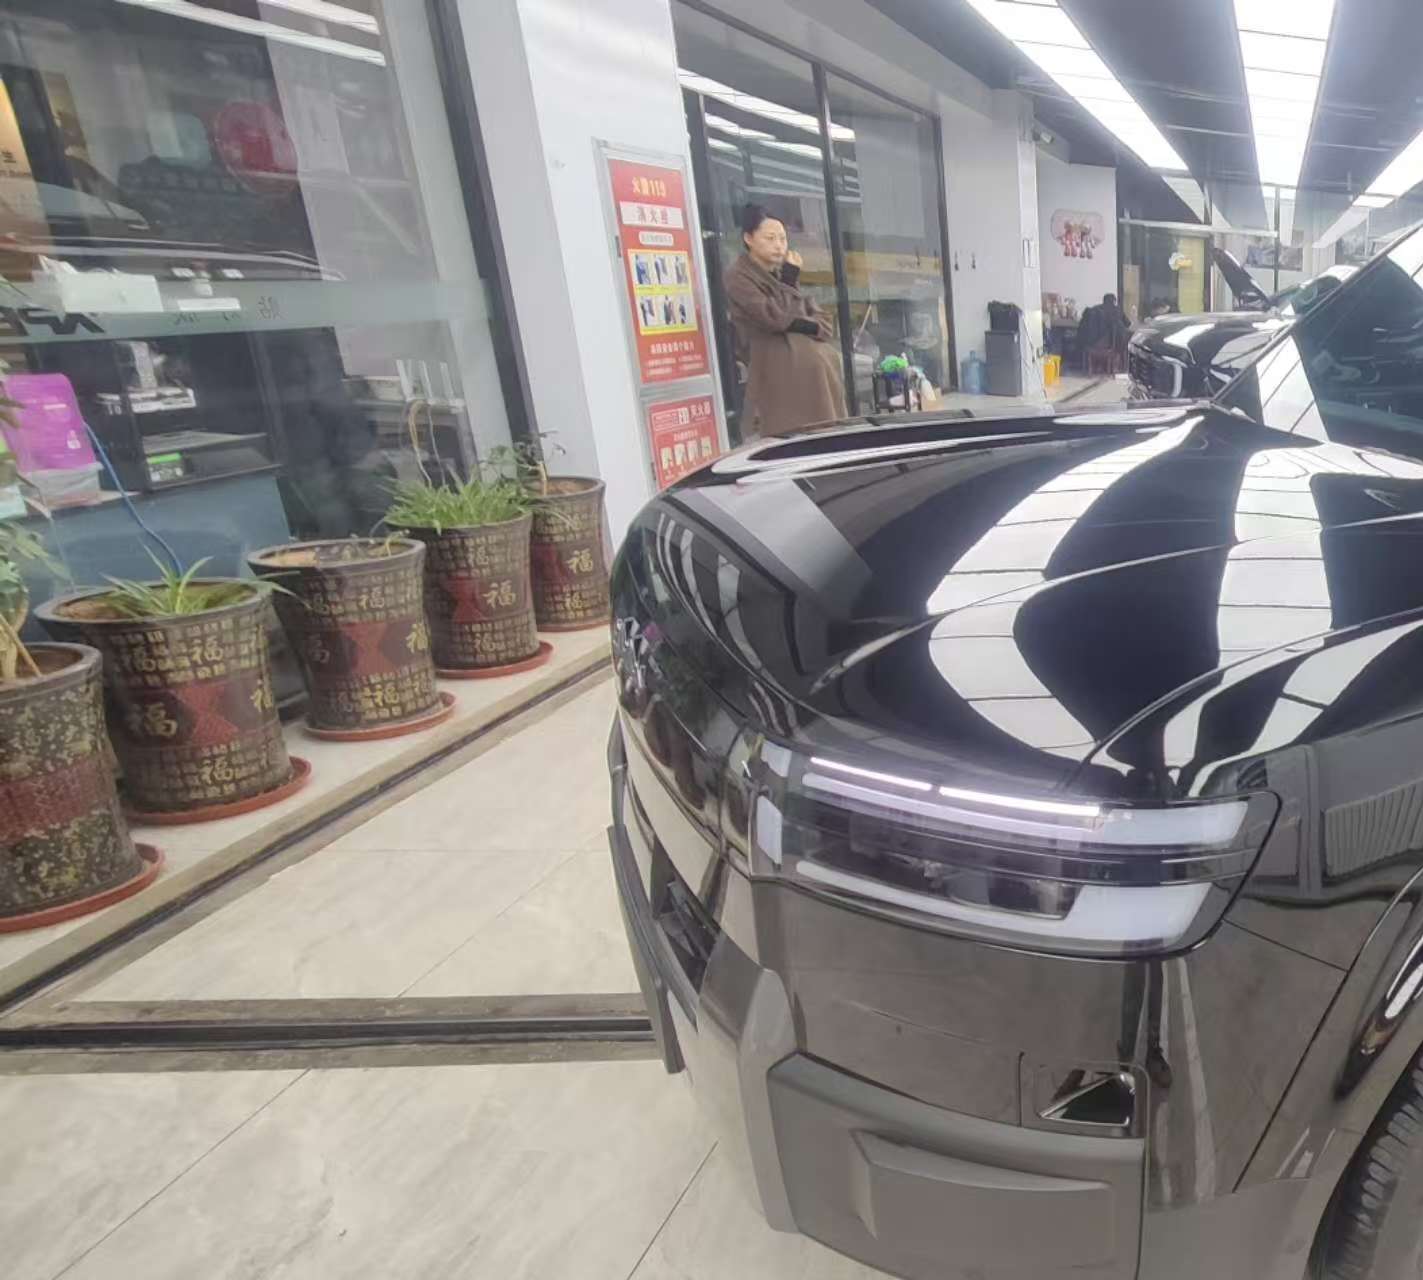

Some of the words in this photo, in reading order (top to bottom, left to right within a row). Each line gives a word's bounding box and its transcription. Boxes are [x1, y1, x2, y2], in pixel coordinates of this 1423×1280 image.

[566, 547, 594, 574] 福
[482, 580, 516, 608] 福
[189, 636, 224, 664] 福
[405, 621, 428, 653] 福
